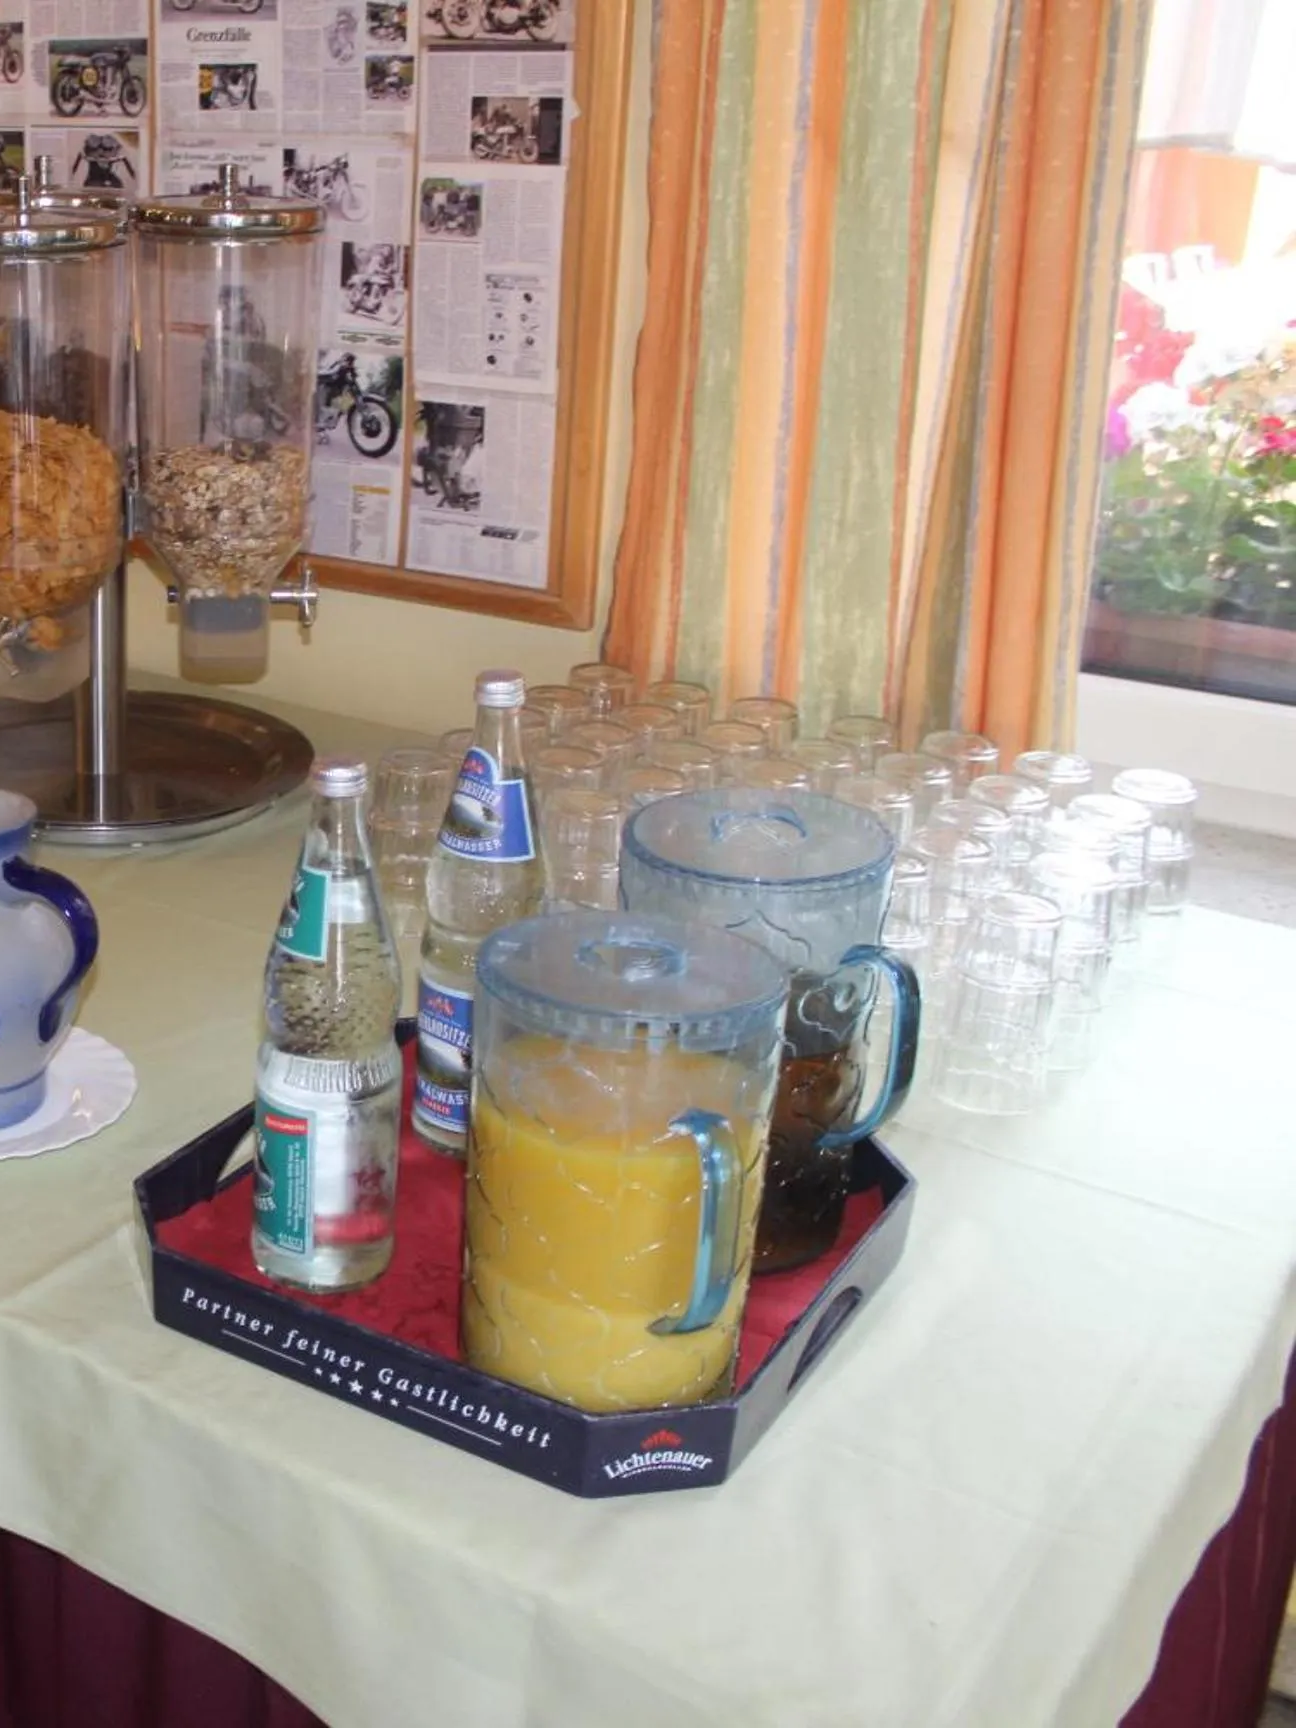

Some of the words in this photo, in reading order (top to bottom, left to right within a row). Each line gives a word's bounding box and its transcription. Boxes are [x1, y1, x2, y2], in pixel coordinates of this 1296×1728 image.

[182, 1287, 274, 1336] Partner
[281, 1329, 365, 1372] feiner
[377, 1367, 551, 1448] Gastlichkeit
[603, 1450, 713, 1480] Lichtenauer
